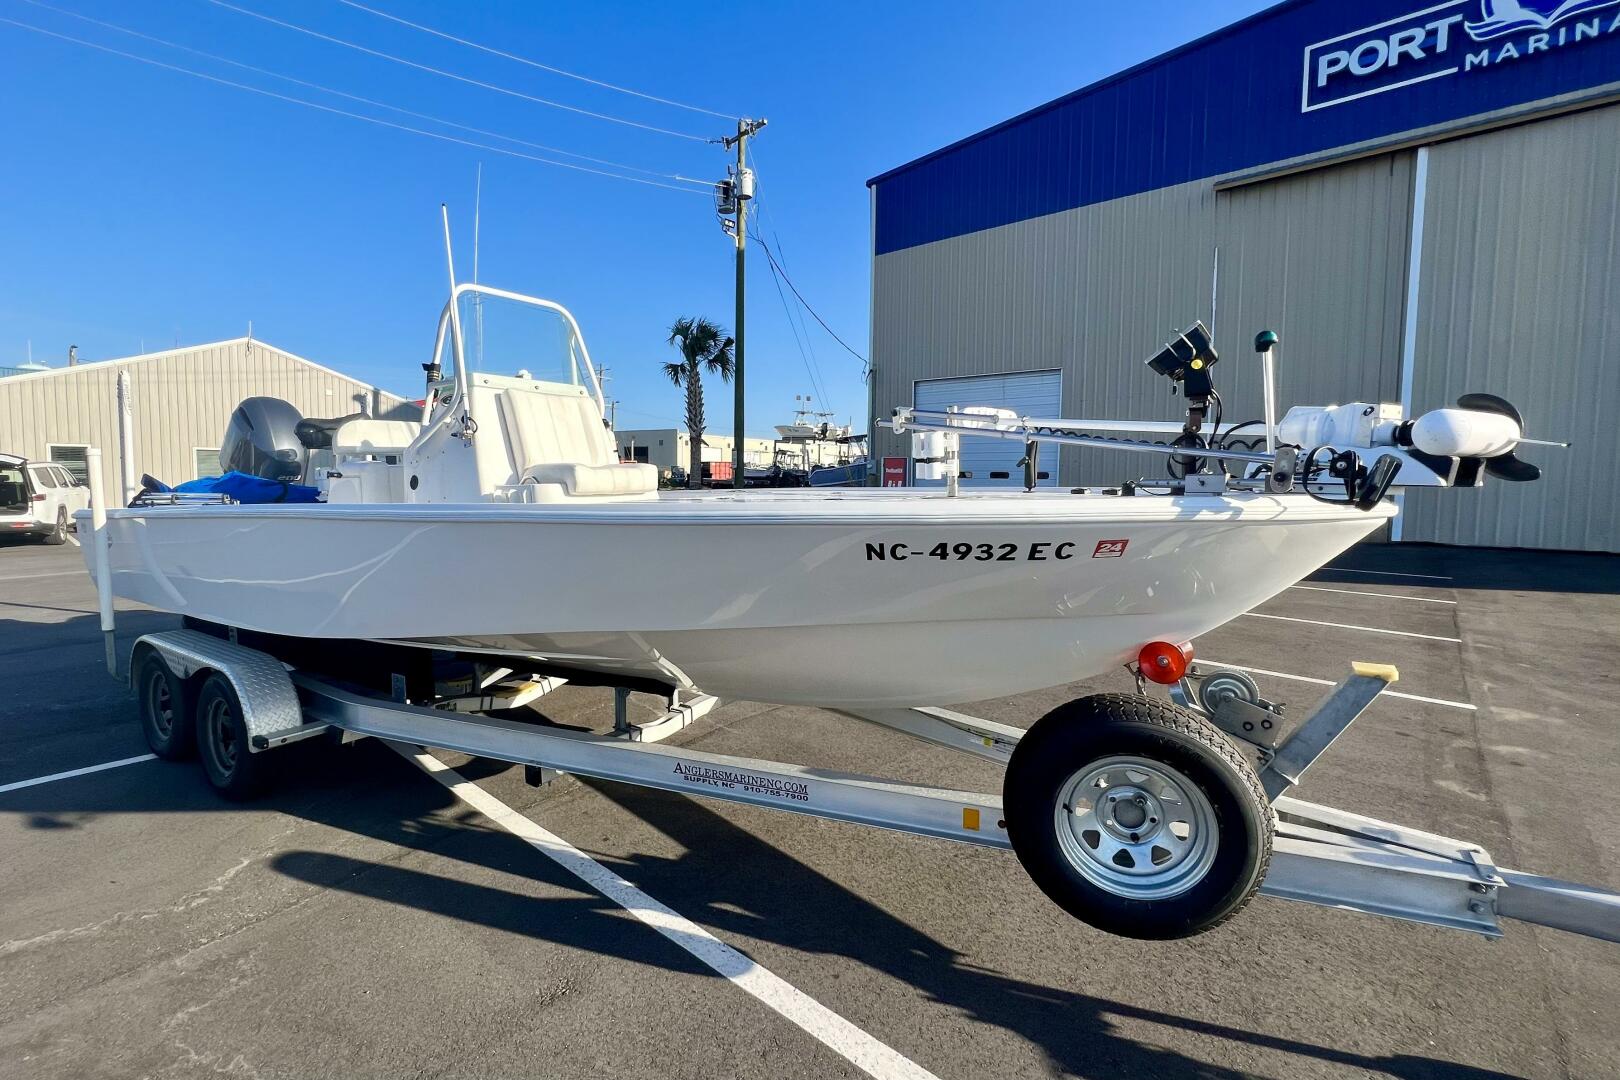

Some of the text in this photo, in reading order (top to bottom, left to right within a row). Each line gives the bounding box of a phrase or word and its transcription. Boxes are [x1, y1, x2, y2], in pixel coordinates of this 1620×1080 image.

[1317, 13, 1463, 88] PORT
[865, 541, 1076, 561] NC-4932 EC
[1097, 542, 1123, 552] 24
[721, 781, 736, 789] NC
[743, 785, 809, 802] 910-755-7900
